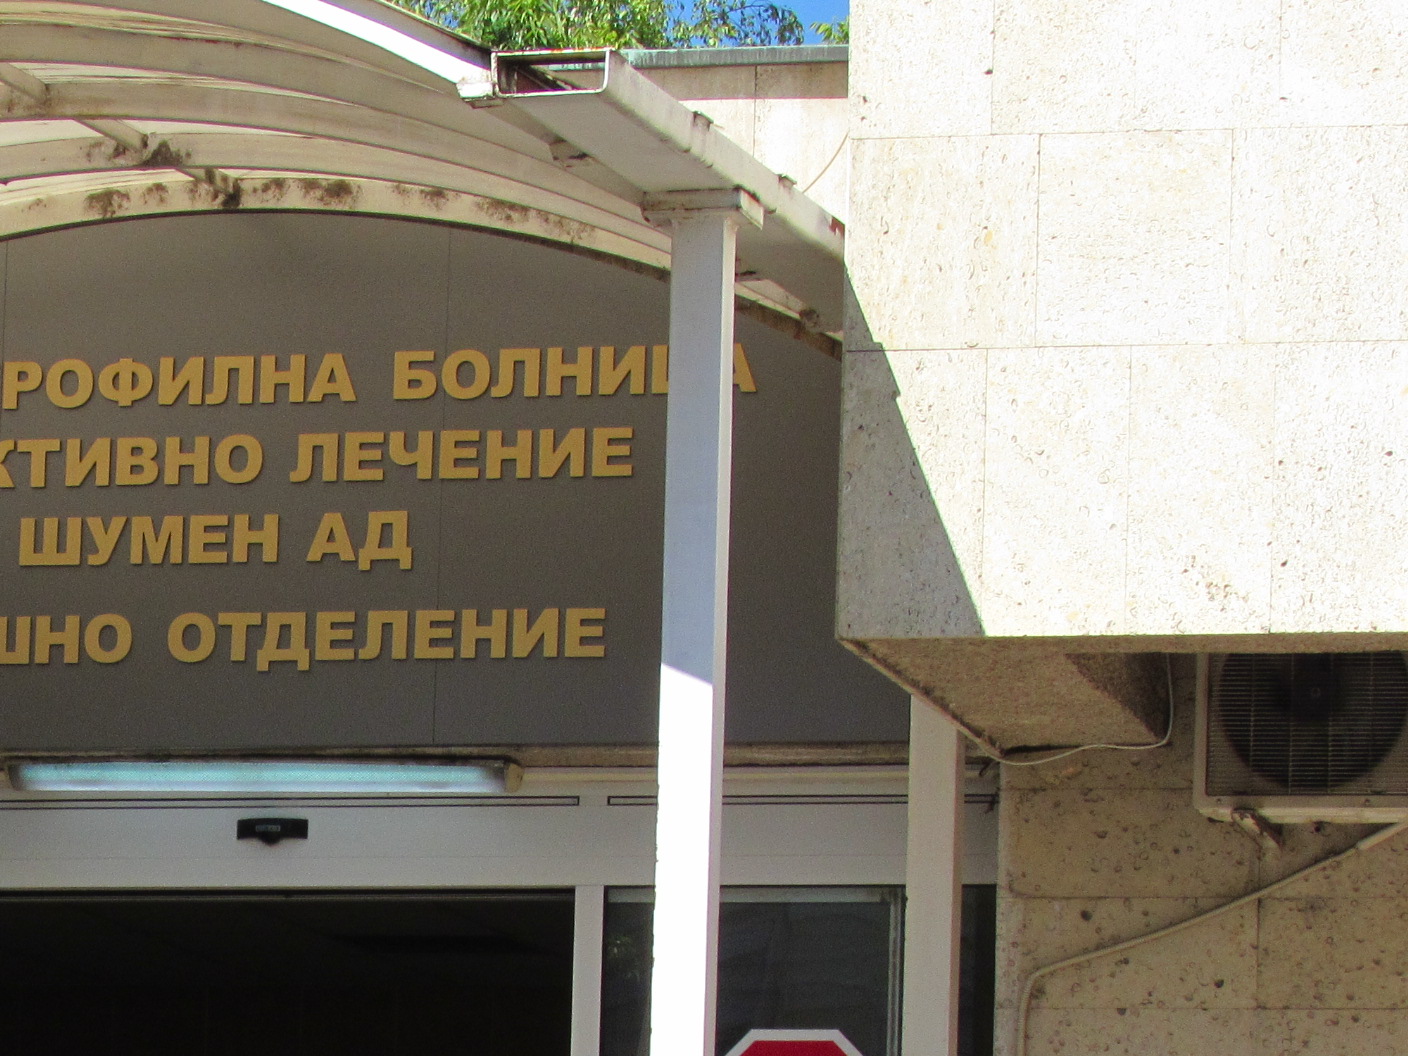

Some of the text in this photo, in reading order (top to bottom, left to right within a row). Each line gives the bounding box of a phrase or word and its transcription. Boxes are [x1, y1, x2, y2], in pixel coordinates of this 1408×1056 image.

[290, 427, 635, 484] ЛЕЧЕНИЕ
[18, 509, 414, 571] ШУМЕН АД
[167, 606, 608, 671] ОТДЕЛЕНИЕ
